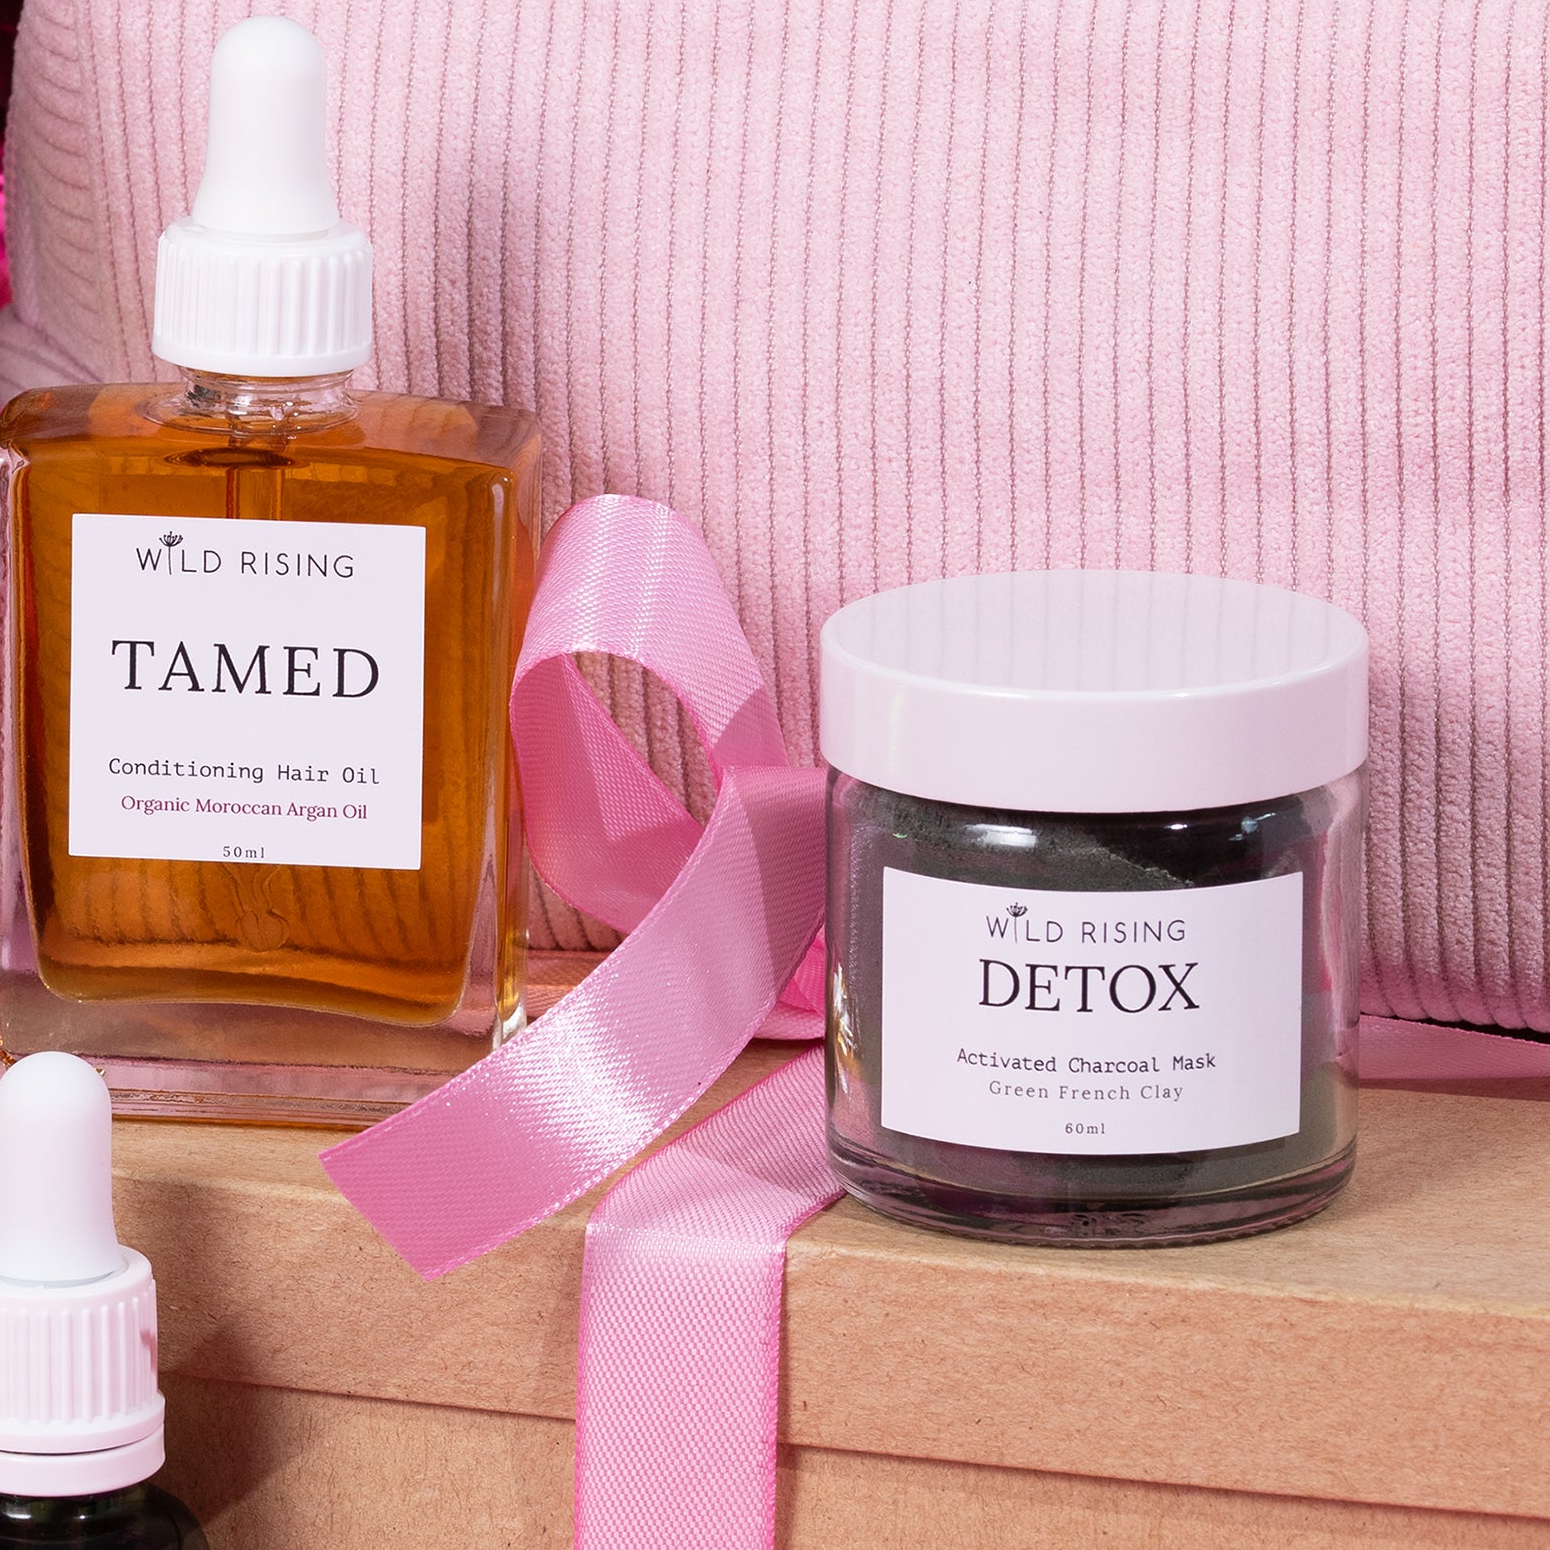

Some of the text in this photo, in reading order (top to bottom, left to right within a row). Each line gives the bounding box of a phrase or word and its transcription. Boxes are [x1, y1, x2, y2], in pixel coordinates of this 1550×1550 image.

[136, 531, 354, 578] WILD RISING
[111, 639, 380, 699] TAMED
[108, 757, 380, 785] Conditioning Hair Oil
[121, 795, 368, 822] Organic Moroccan Argan Oil
[222, 845, 266, 860] 50ml
[985, 901, 1187, 944] WILD RISING
[978, 958, 1201, 1014] DETOX
[956, 1047, 1217, 1075] Activated Charcoal Mask
[988, 1080, 1185, 1103] Green French Clay
[1064, 1122, 1106, 1136] 60ml
